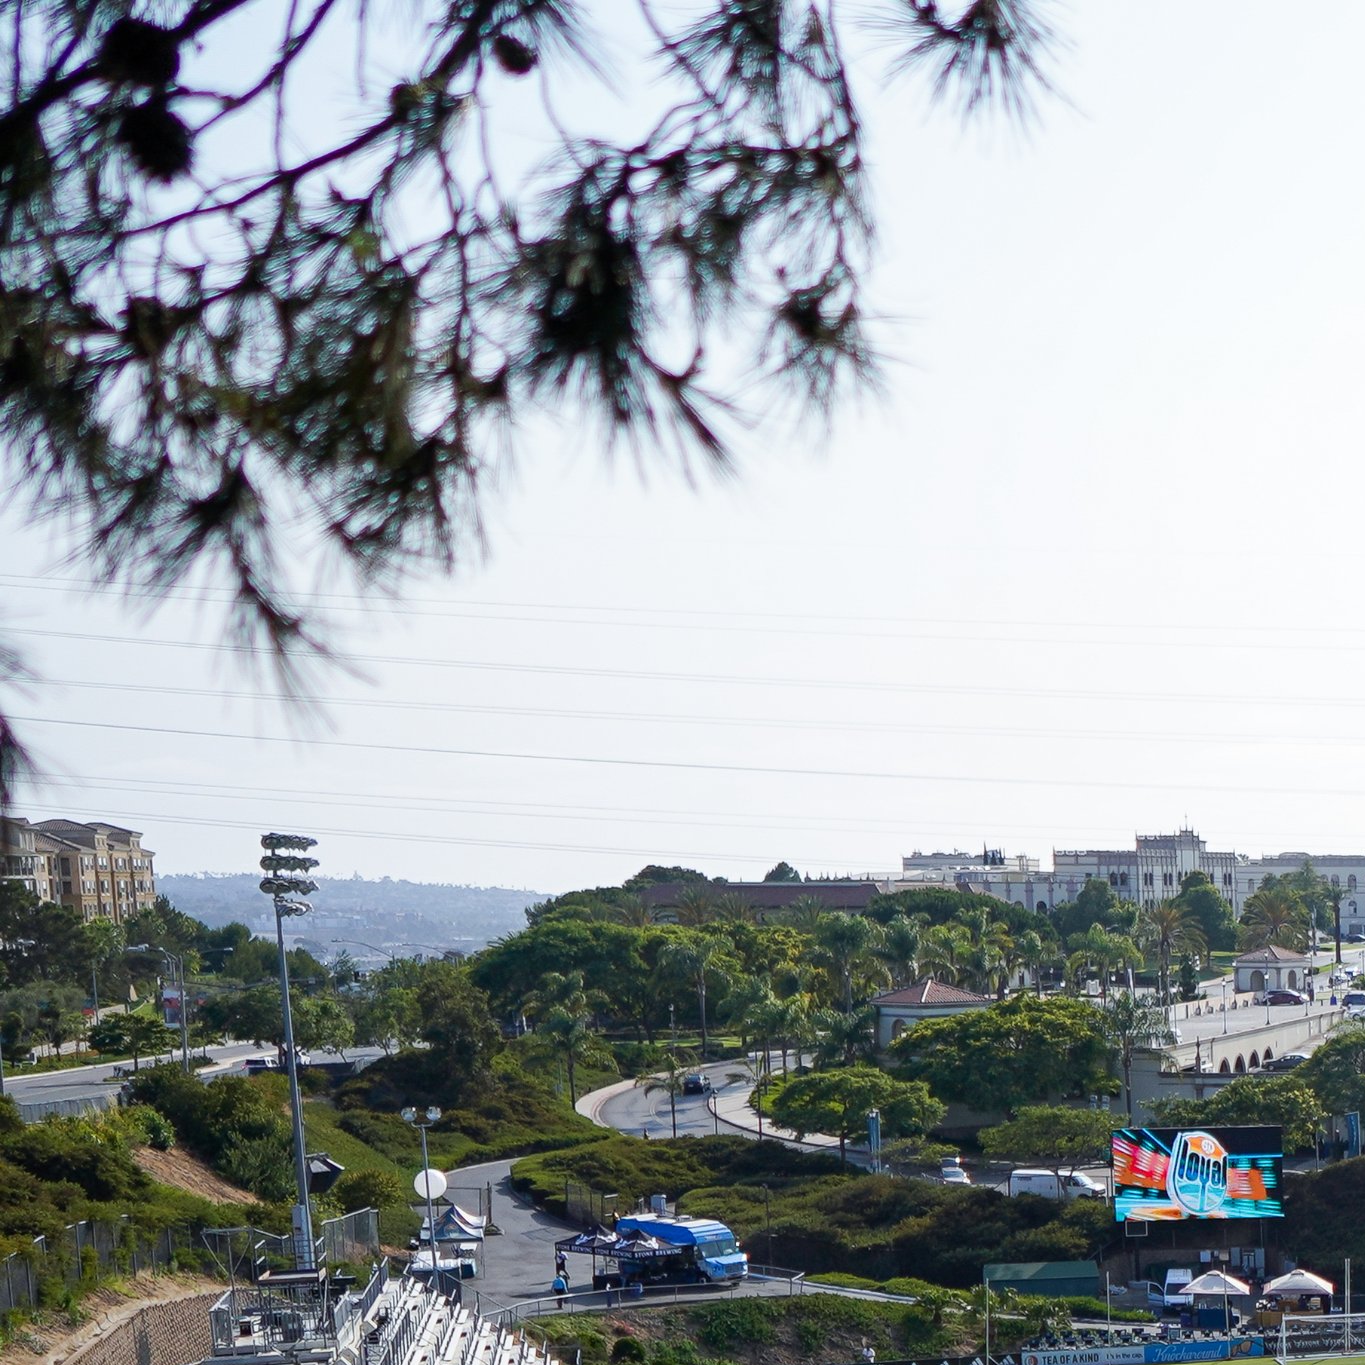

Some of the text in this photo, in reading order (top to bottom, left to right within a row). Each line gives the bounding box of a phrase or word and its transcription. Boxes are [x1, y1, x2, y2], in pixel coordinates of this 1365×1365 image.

[1177, 1139, 1227, 1189] loyal
[1042, 1353, 1100, 1365] TEA OF A KIND
